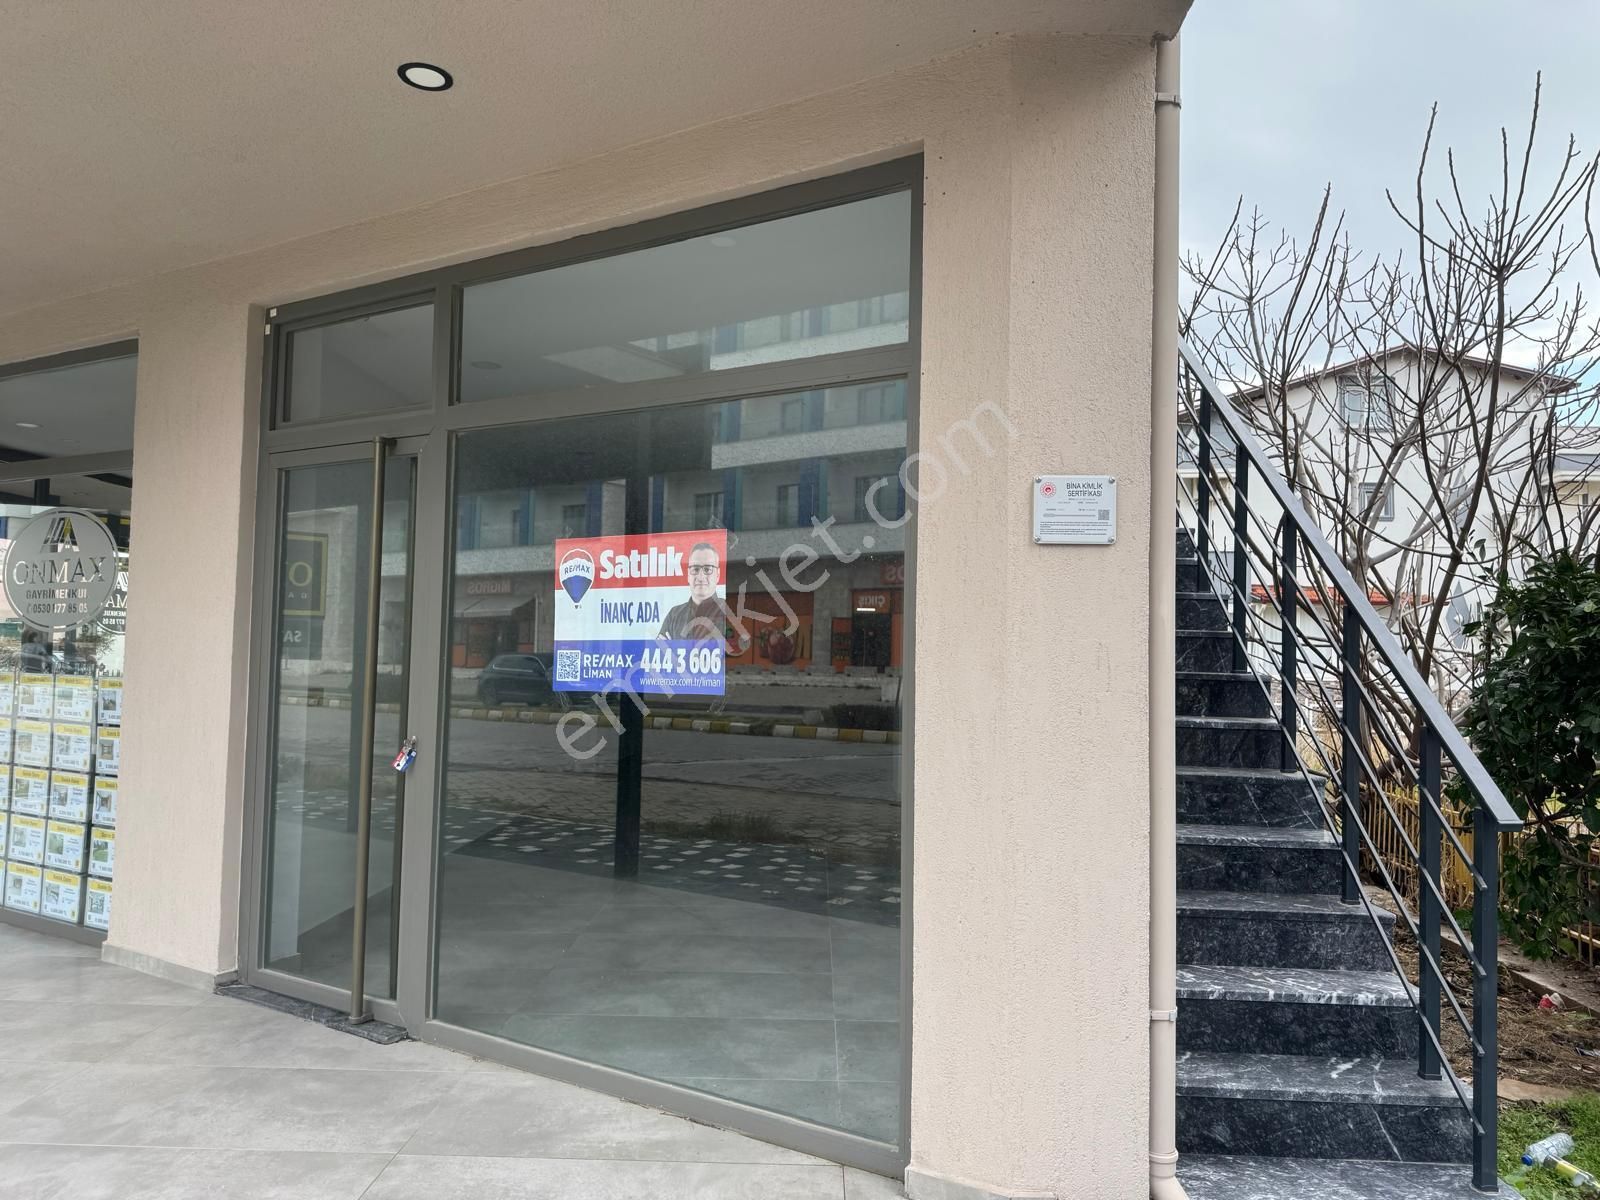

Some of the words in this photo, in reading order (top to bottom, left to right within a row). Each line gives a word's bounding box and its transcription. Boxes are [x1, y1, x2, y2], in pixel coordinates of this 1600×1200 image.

[1066, 482, 1081, 490] BİNA
[564, 563, 591, 575] RE/MAX
[600, 547, 683, 579] Satılık
[13, 556, 107, 585] ONMAX
[600, 598, 634, 627] İNANÇ
[637, 601, 660, 623] ADA
[583, 654, 633, 668] RE/MAX
[640, 648, 673, 674] 444
[676, 648, 687, 674] 3
[689, 648, 722, 675] 606
[583, 666, 612, 679] LİMAN
[639, 676, 721, 687] www.remax.com.tr/liman
